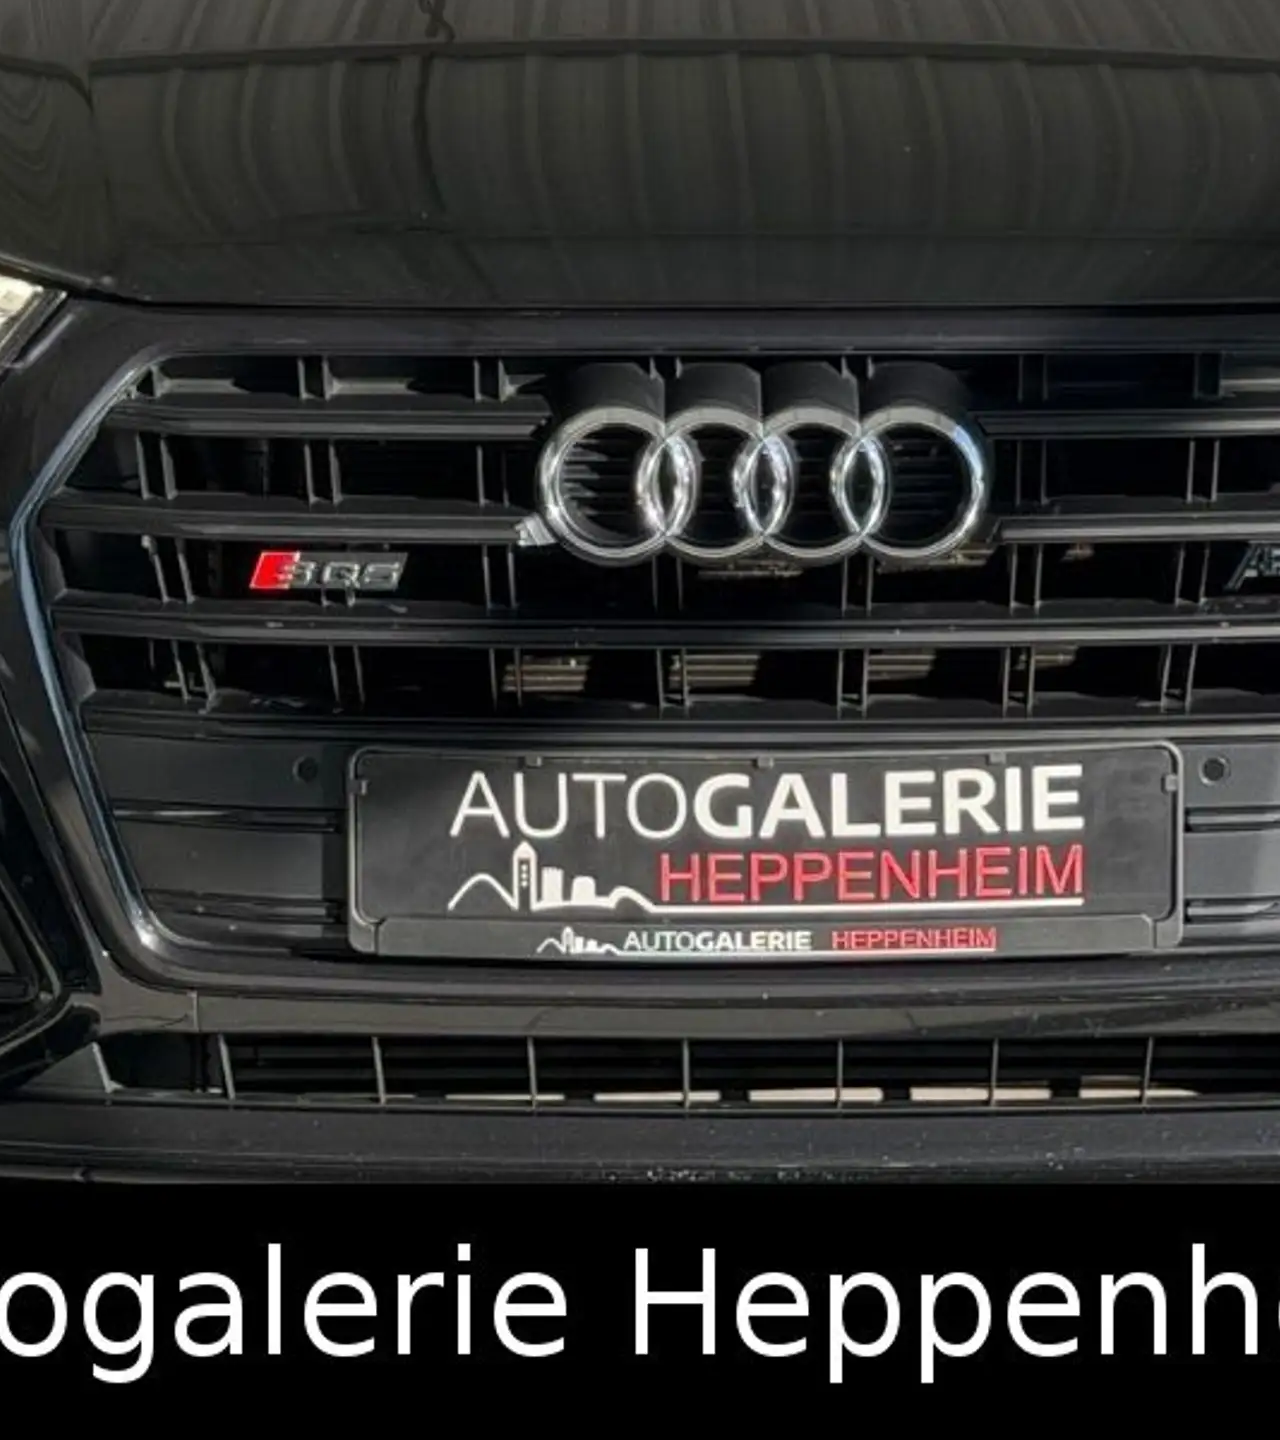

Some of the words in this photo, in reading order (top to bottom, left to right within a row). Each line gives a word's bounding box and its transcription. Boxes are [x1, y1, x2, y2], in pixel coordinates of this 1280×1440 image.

[450, 764, 1085, 840] AUTOGALERIE
[658, 844, 1084, 904] HEPPENHEIM
[622, 930, 812, 953] AUTOGALERIE
[831, 926, 996, 951] HEPPENHEIM
